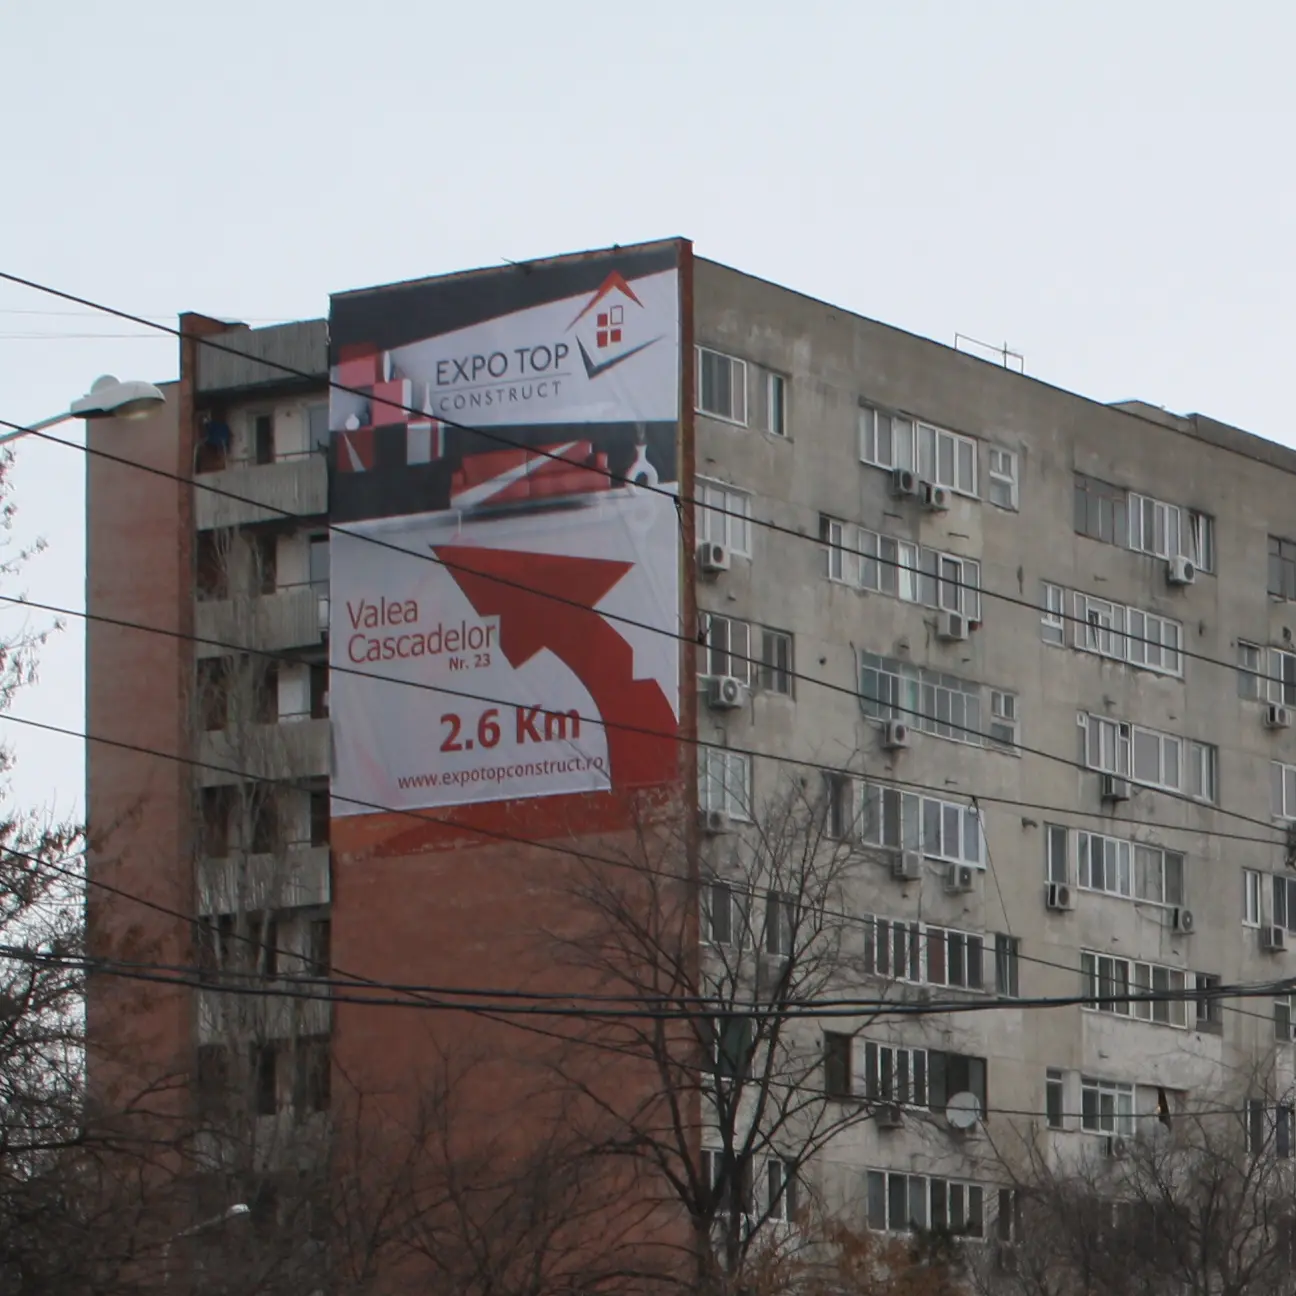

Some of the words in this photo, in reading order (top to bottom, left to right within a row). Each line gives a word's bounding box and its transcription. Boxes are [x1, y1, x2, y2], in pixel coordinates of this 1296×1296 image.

[436, 351, 508, 386] EXPO
[514, 342, 570, 374] TOP
[439, 380, 563, 412] CONSTRUCT
[347, 596, 418, 630] Valea
[347, 621, 496, 664] Cascadelor
[449, 657, 469, 671] Nr.
[474, 654, 491, 669] 23
[439, 709, 501, 753] 2.6
[516, 704, 581, 745] Km
[398, 757, 604, 789] www.expotopconstruct.ro
